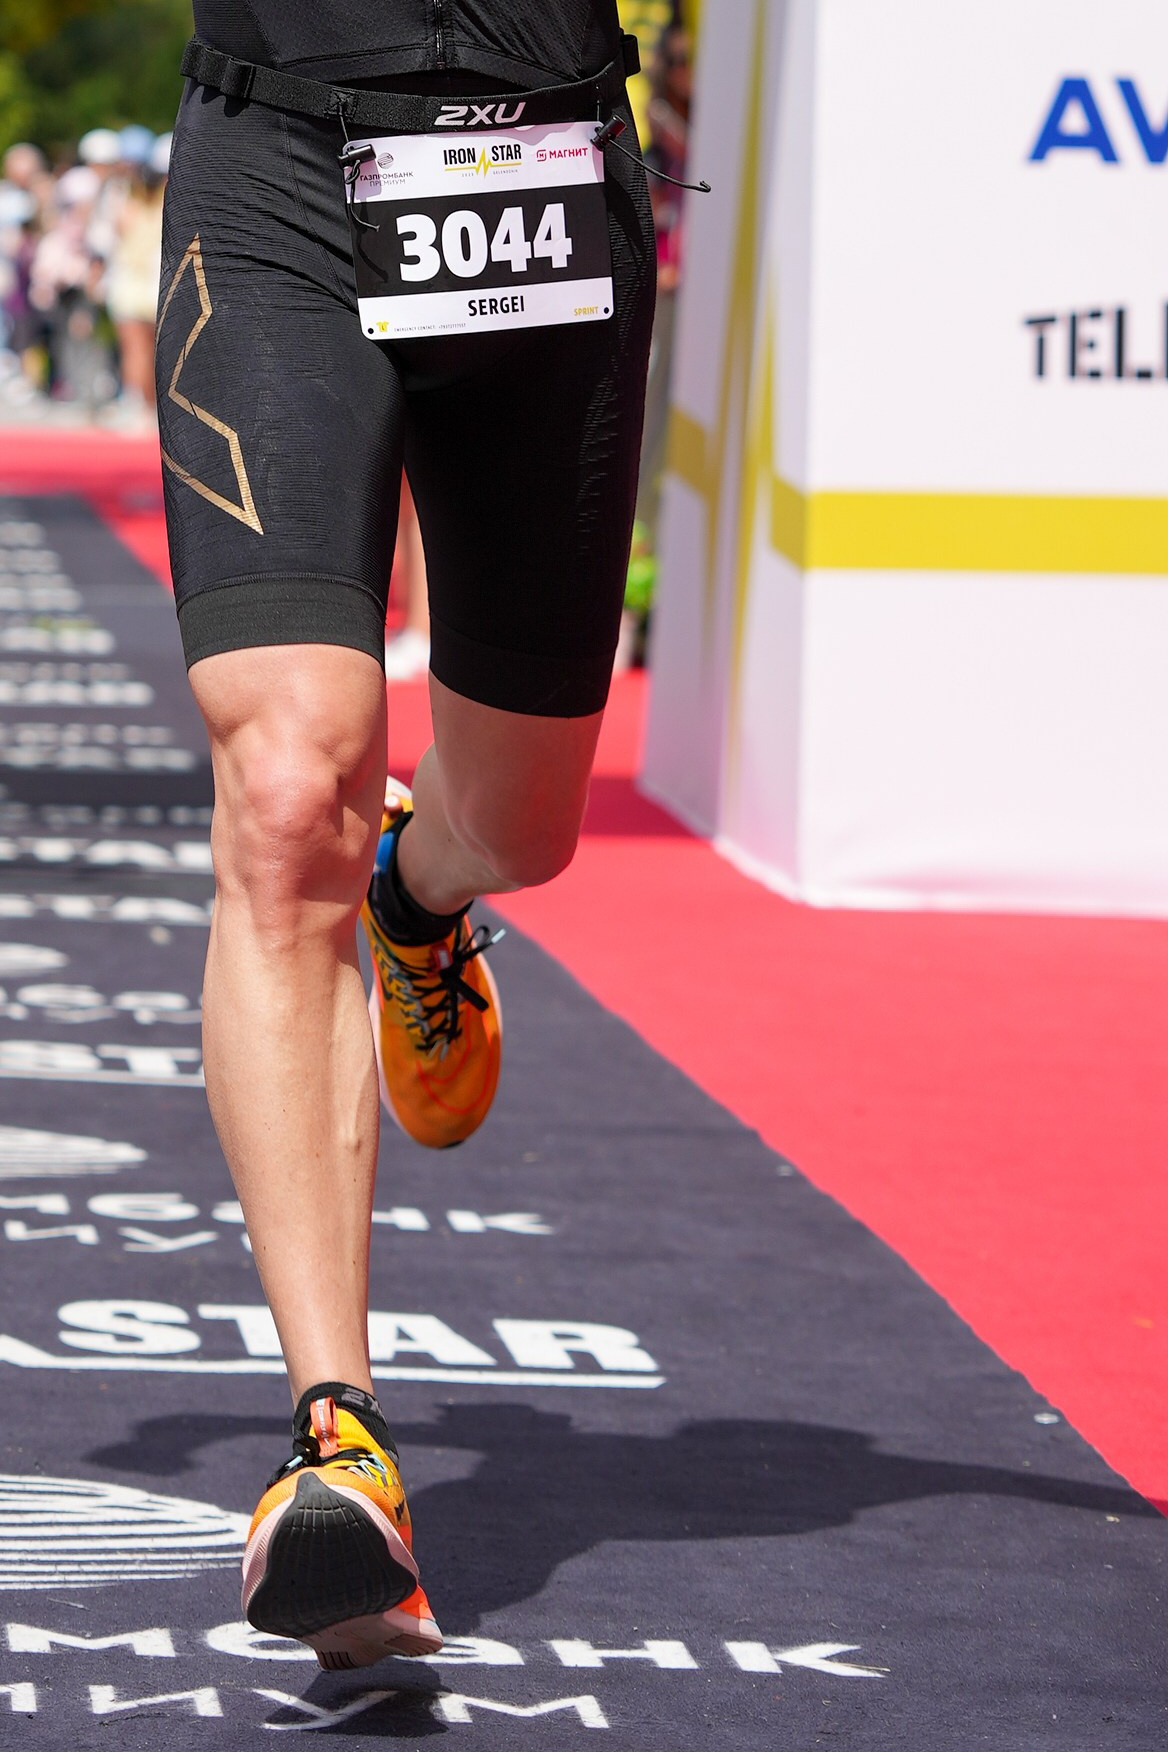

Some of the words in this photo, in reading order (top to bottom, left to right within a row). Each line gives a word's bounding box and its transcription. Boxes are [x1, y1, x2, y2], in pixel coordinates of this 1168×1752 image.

[434, 101, 526, 127] 2XU
[443, 147, 476, 165] IRON
[491, 144, 522, 162] STAR
[549, 147, 589, 159] МАГНИТ
[360, 171, 414, 181] ГАЗПРОМБАНК
[369, 178, 406, 187] ПРЕМИУМ
[396, 203, 573, 282] 3044
[467, 295, 525, 317] SERGEI
[573, 305, 599, 316] SPRINT
[57, 1298, 662, 1372] STAR
